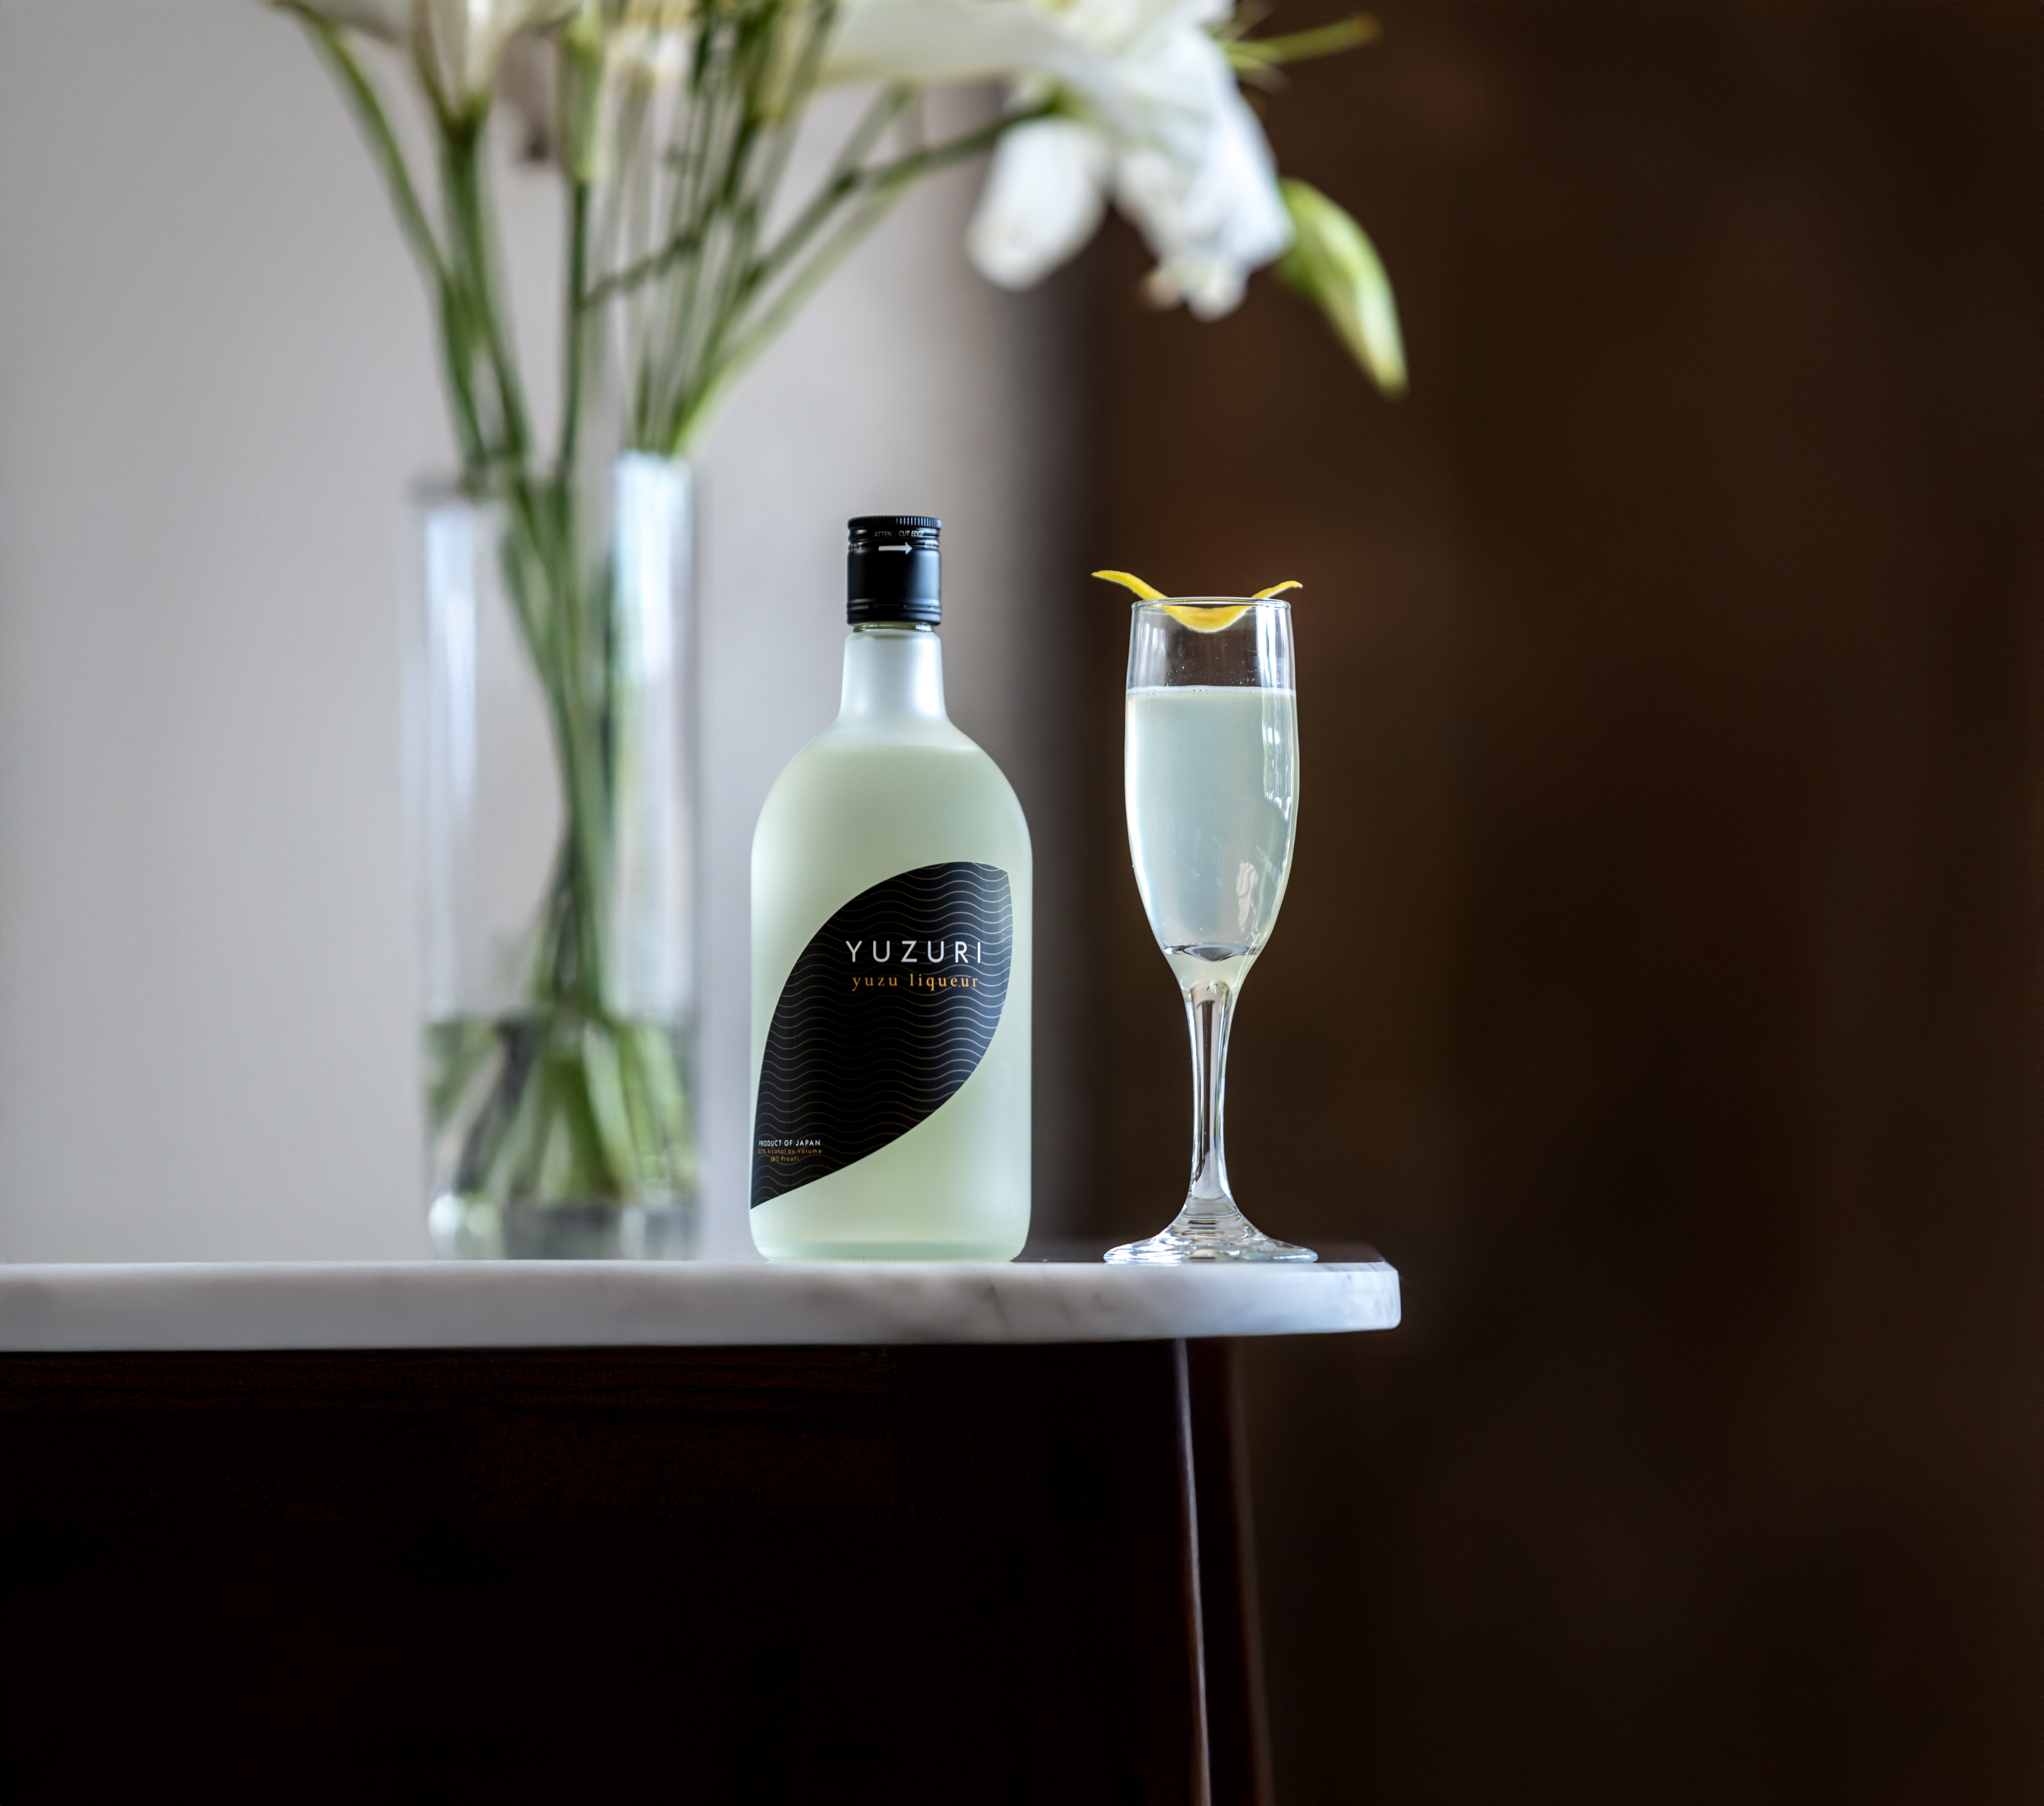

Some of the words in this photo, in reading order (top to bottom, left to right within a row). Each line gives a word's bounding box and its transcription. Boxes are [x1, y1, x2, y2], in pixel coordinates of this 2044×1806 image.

[845, 940, 981, 963] YUZURI
[852, 977, 898, 991] yuzu
[909, 973, 978, 991] liqueur
